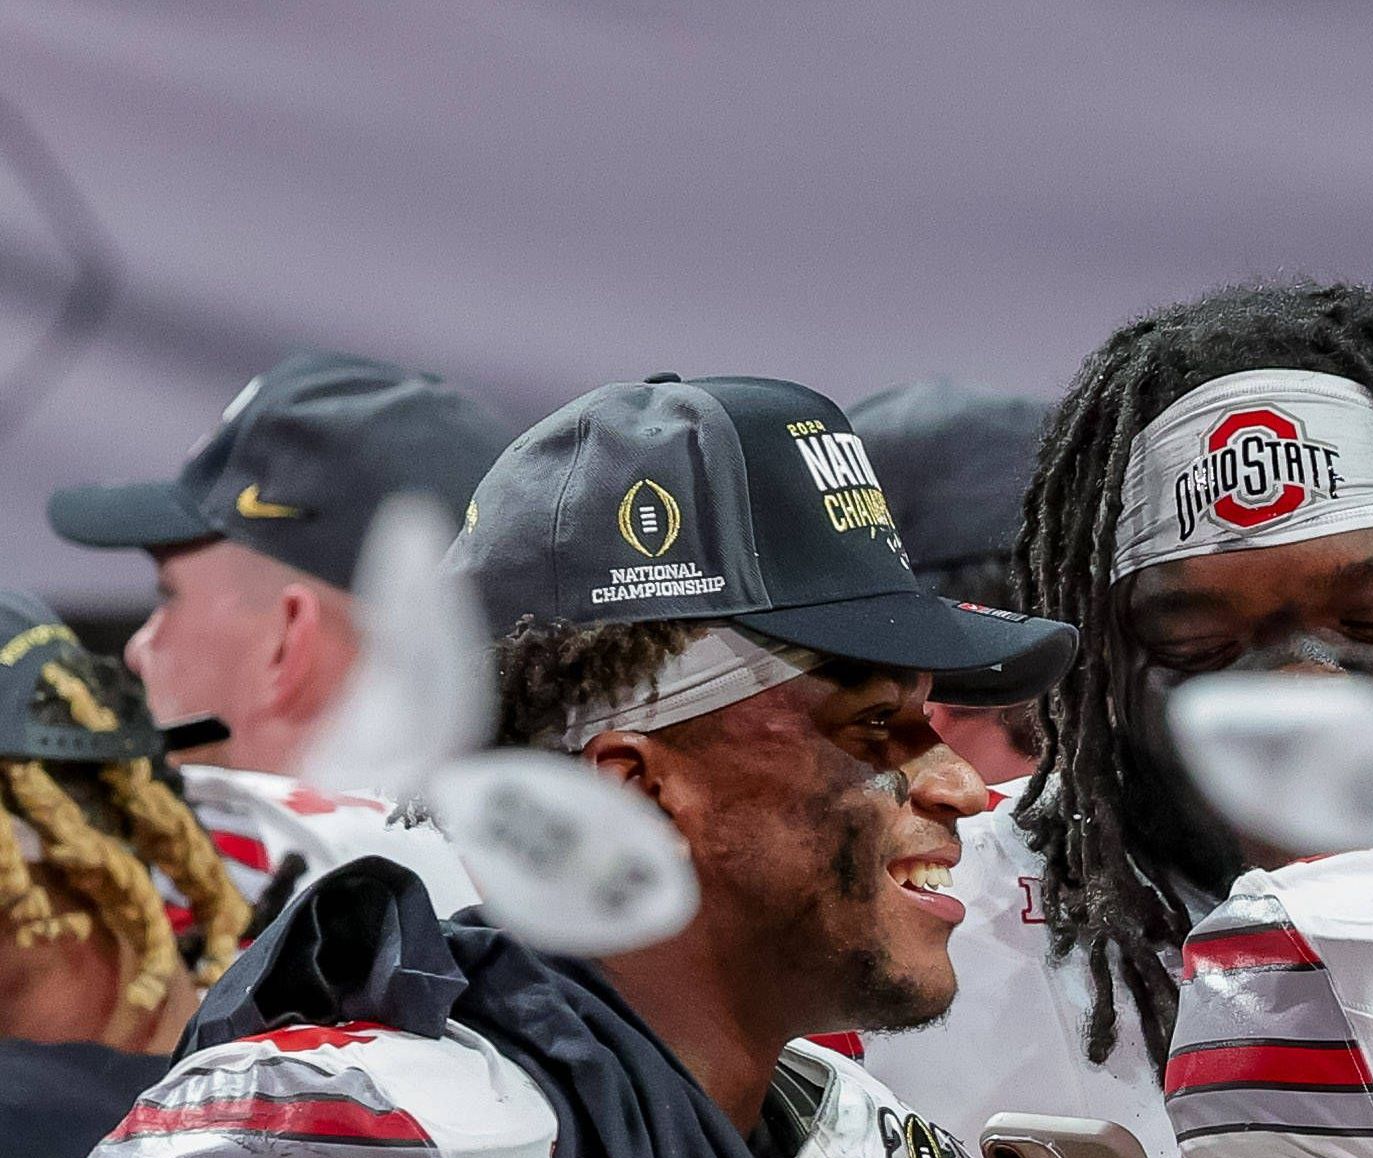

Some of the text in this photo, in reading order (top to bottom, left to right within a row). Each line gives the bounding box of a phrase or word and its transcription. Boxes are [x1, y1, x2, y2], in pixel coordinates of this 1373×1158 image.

[786, 419, 827, 438] 2024
[1174, 435, 1346, 542] OHIO STATE
[609, 562, 703, 585] NATIONAL
[591, 575, 727, 604] CHAMPIONSHIP
